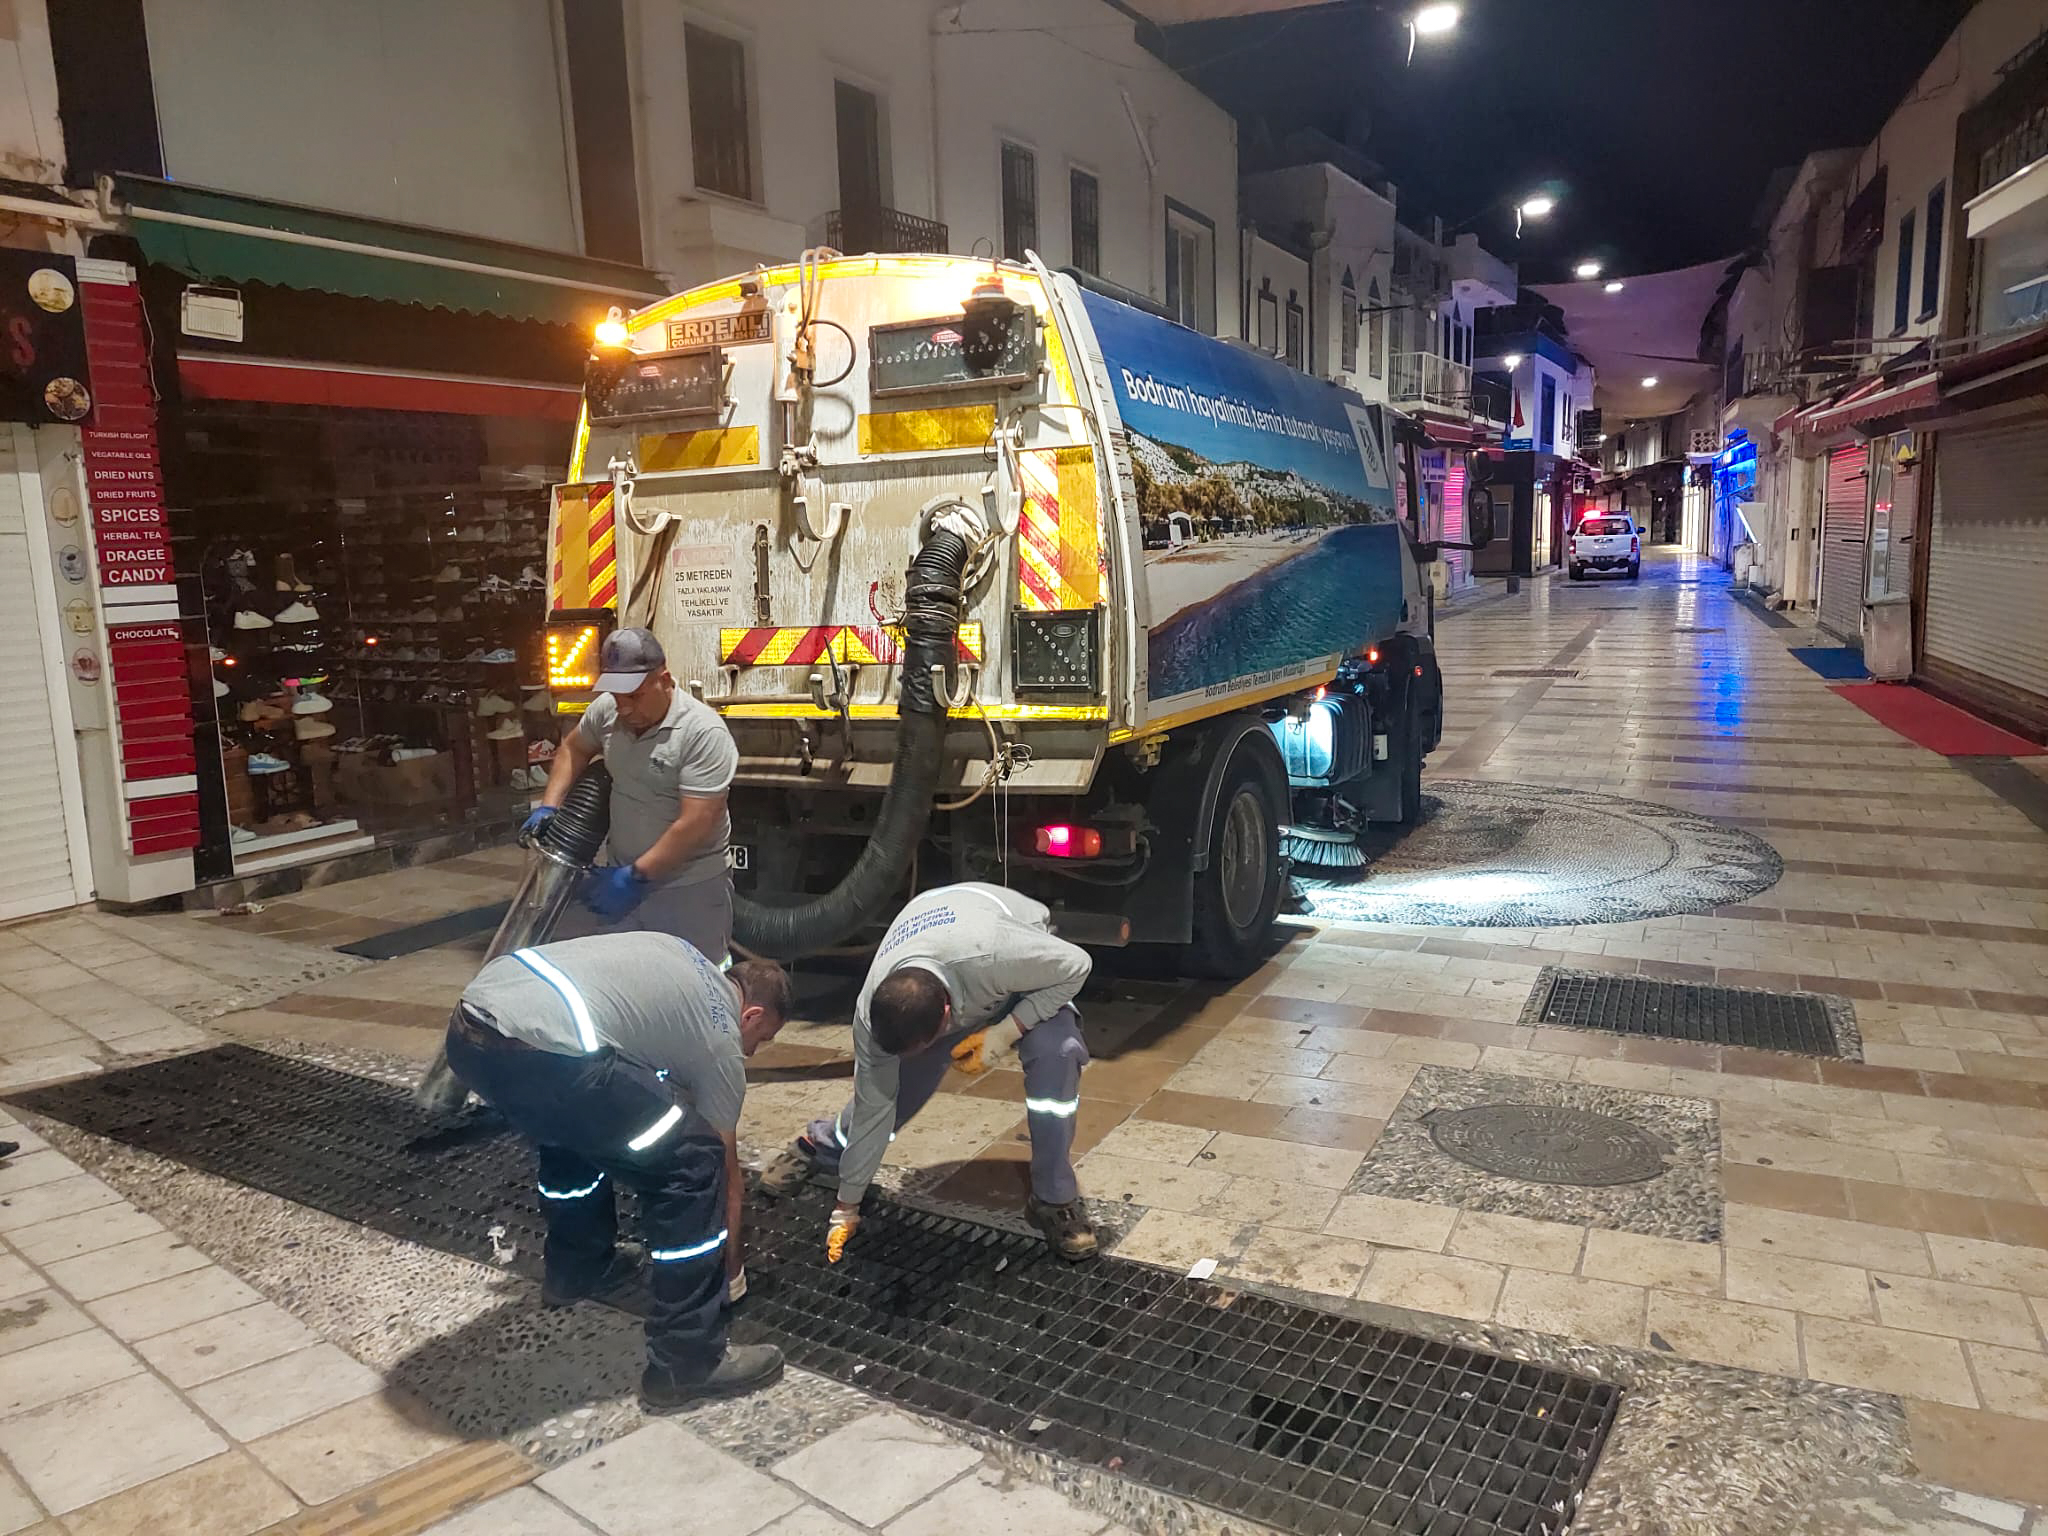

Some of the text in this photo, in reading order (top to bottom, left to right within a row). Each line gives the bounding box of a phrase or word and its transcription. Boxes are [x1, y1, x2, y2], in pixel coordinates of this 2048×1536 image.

[1121, 367, 1190, 414] Bodrum
[1251, 405, 1286, 435] temiz
[1283, 413, 1322, 444] tutarak
[94, 471, 154, 480] DRIED NUTS
[97, 490, 157, 499] DRIED FRUITS
[100, 508, 160, 523] SPICES
[103, 531, 162, 541] HERBAL TEA
[105, 549, 165, 563] DRAGEE
[108, 567, 167, 583] CANDY
[675, 569, 732, 582] 25 METREDEN
[719, 597, 729, 606] VE
[687, 608, 724, 617] YASAKTIR
